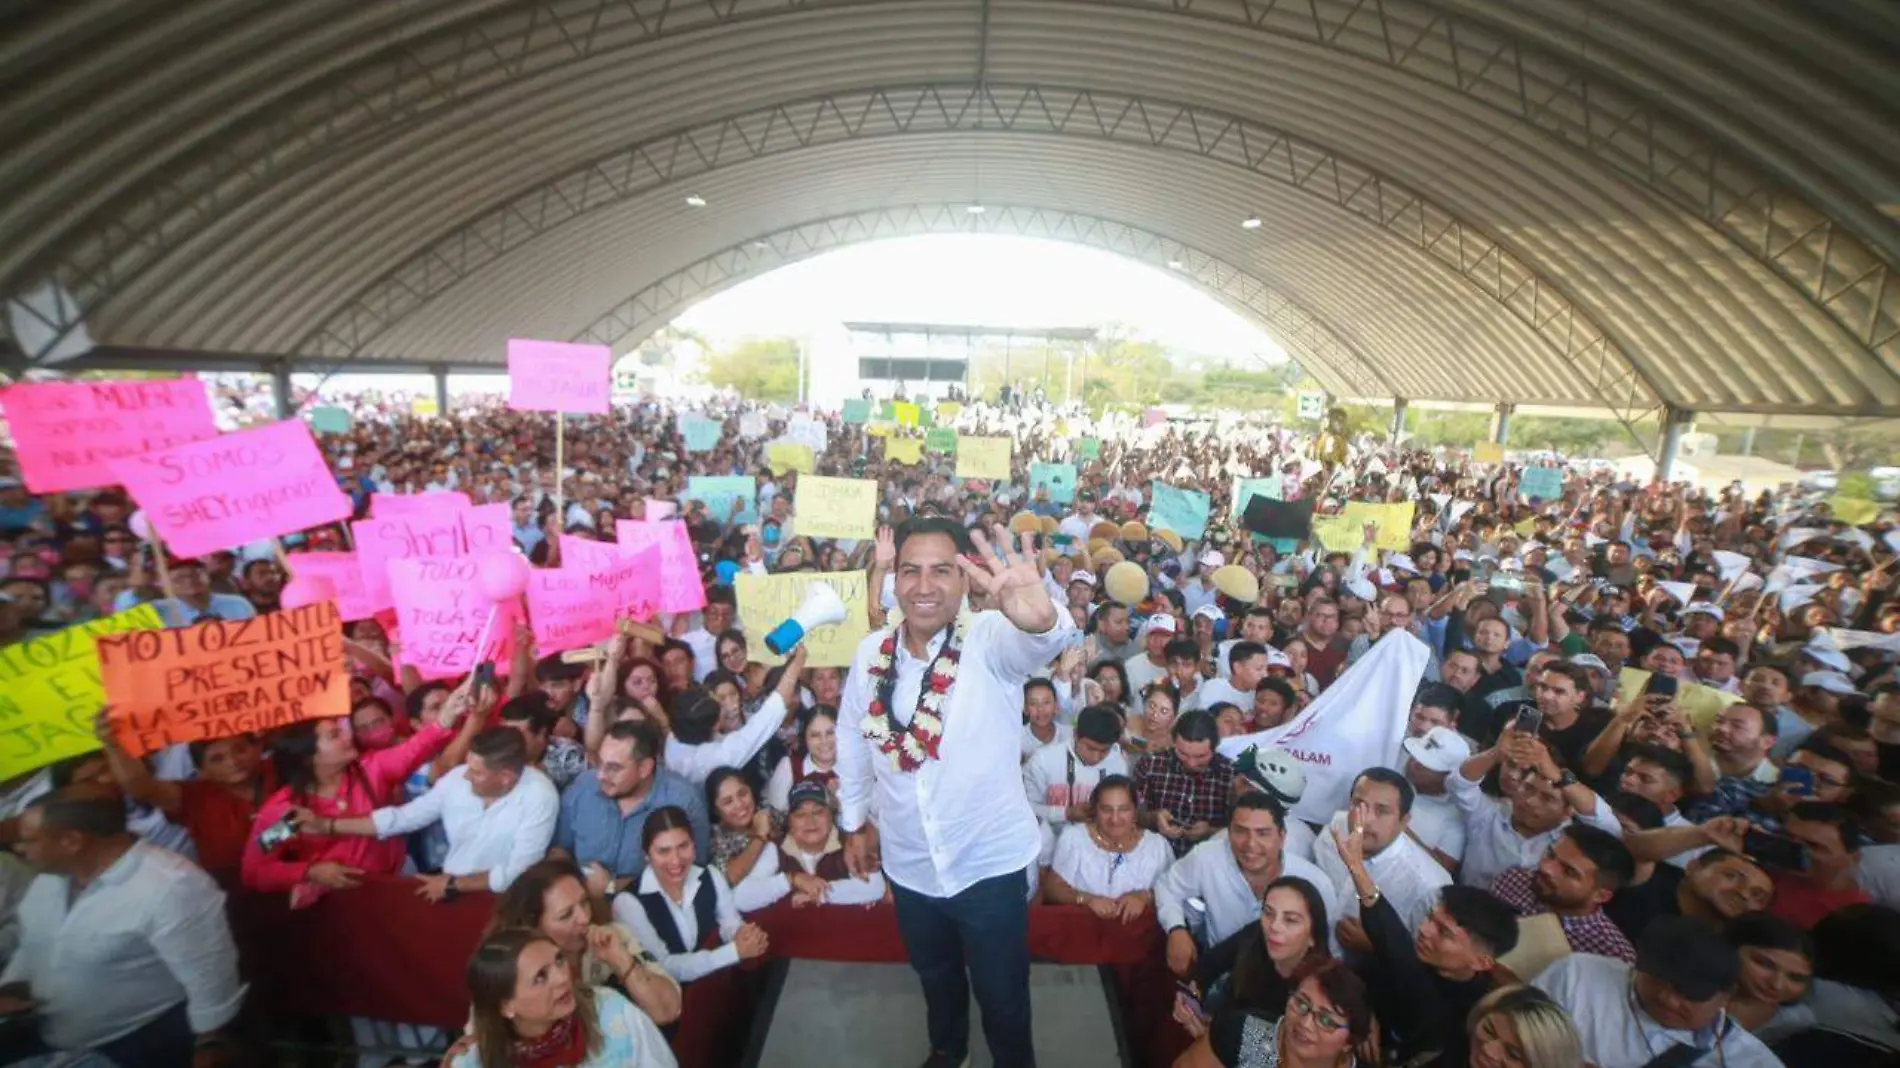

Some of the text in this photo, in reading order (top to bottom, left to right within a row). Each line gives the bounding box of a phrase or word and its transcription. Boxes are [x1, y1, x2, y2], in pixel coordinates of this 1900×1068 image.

[158, 440, 288, 484] SOMOS
[96, 600, 342, 666] MOTOZINTLA
[163, 628, 340, 701] PRESENTE
[174, 685, 269, 722] SIERRA
[276, 668, 333, 704] CON
[194, 701, 306, 740] JAGUAR
